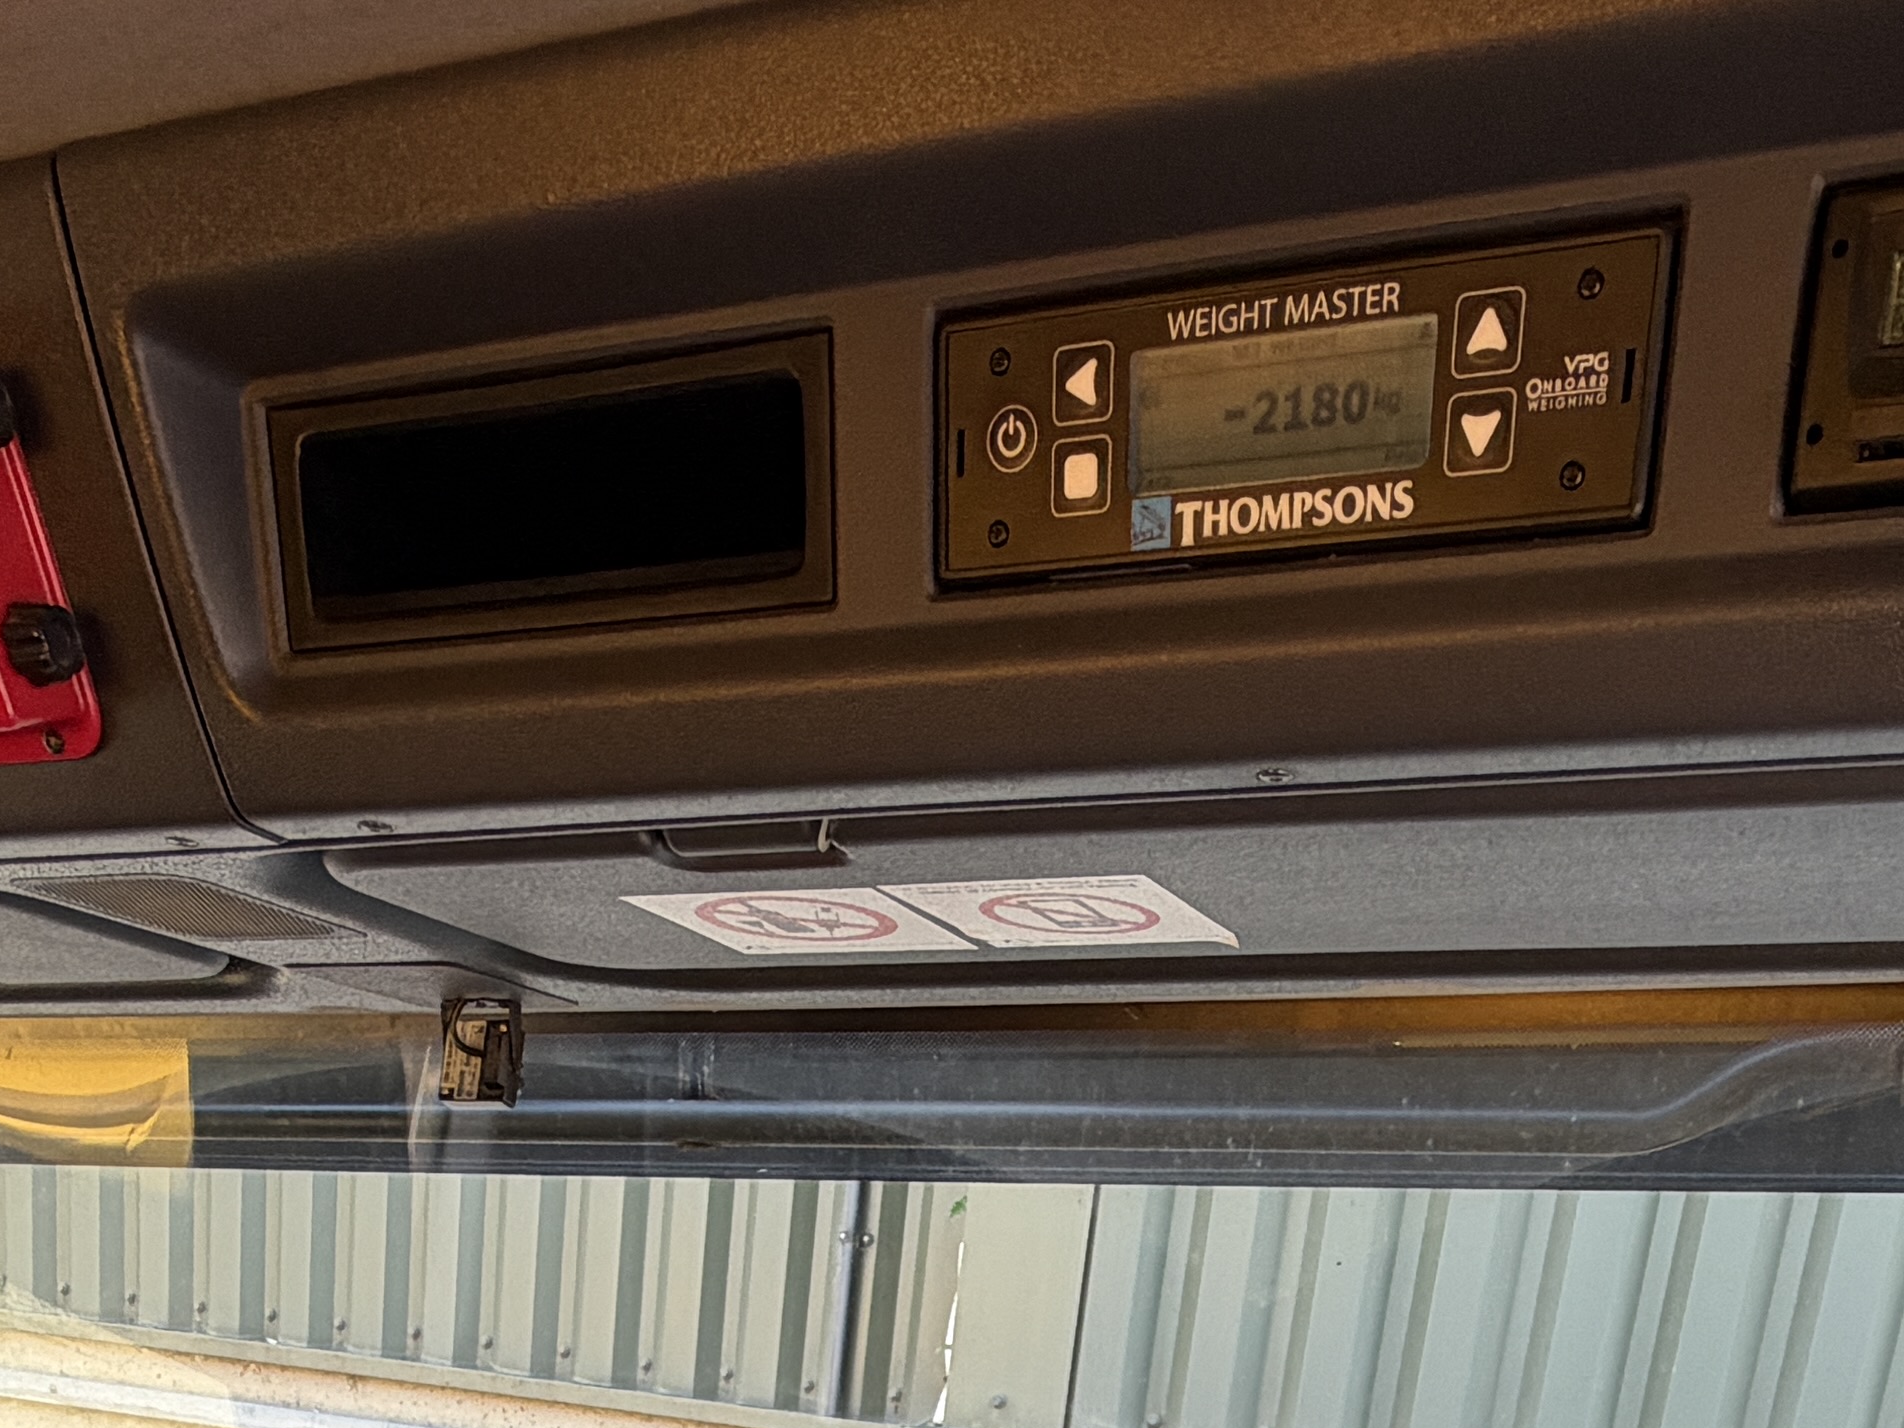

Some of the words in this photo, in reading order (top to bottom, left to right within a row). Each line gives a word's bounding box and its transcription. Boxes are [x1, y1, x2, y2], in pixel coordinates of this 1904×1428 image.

[1167, 298, 1280, 341] WEIGHT
[1284, 282, 1400, 325] MASTER
[1564, 351, 1609, 375] VPG
[1525, 373, 1609, 399] ONBOARD
[1527, 392, 1607, 412] WEIGHING
[1224, 381, 1371, 436] -2180
[1175, 481, 1414, 547] THOMPSONS
